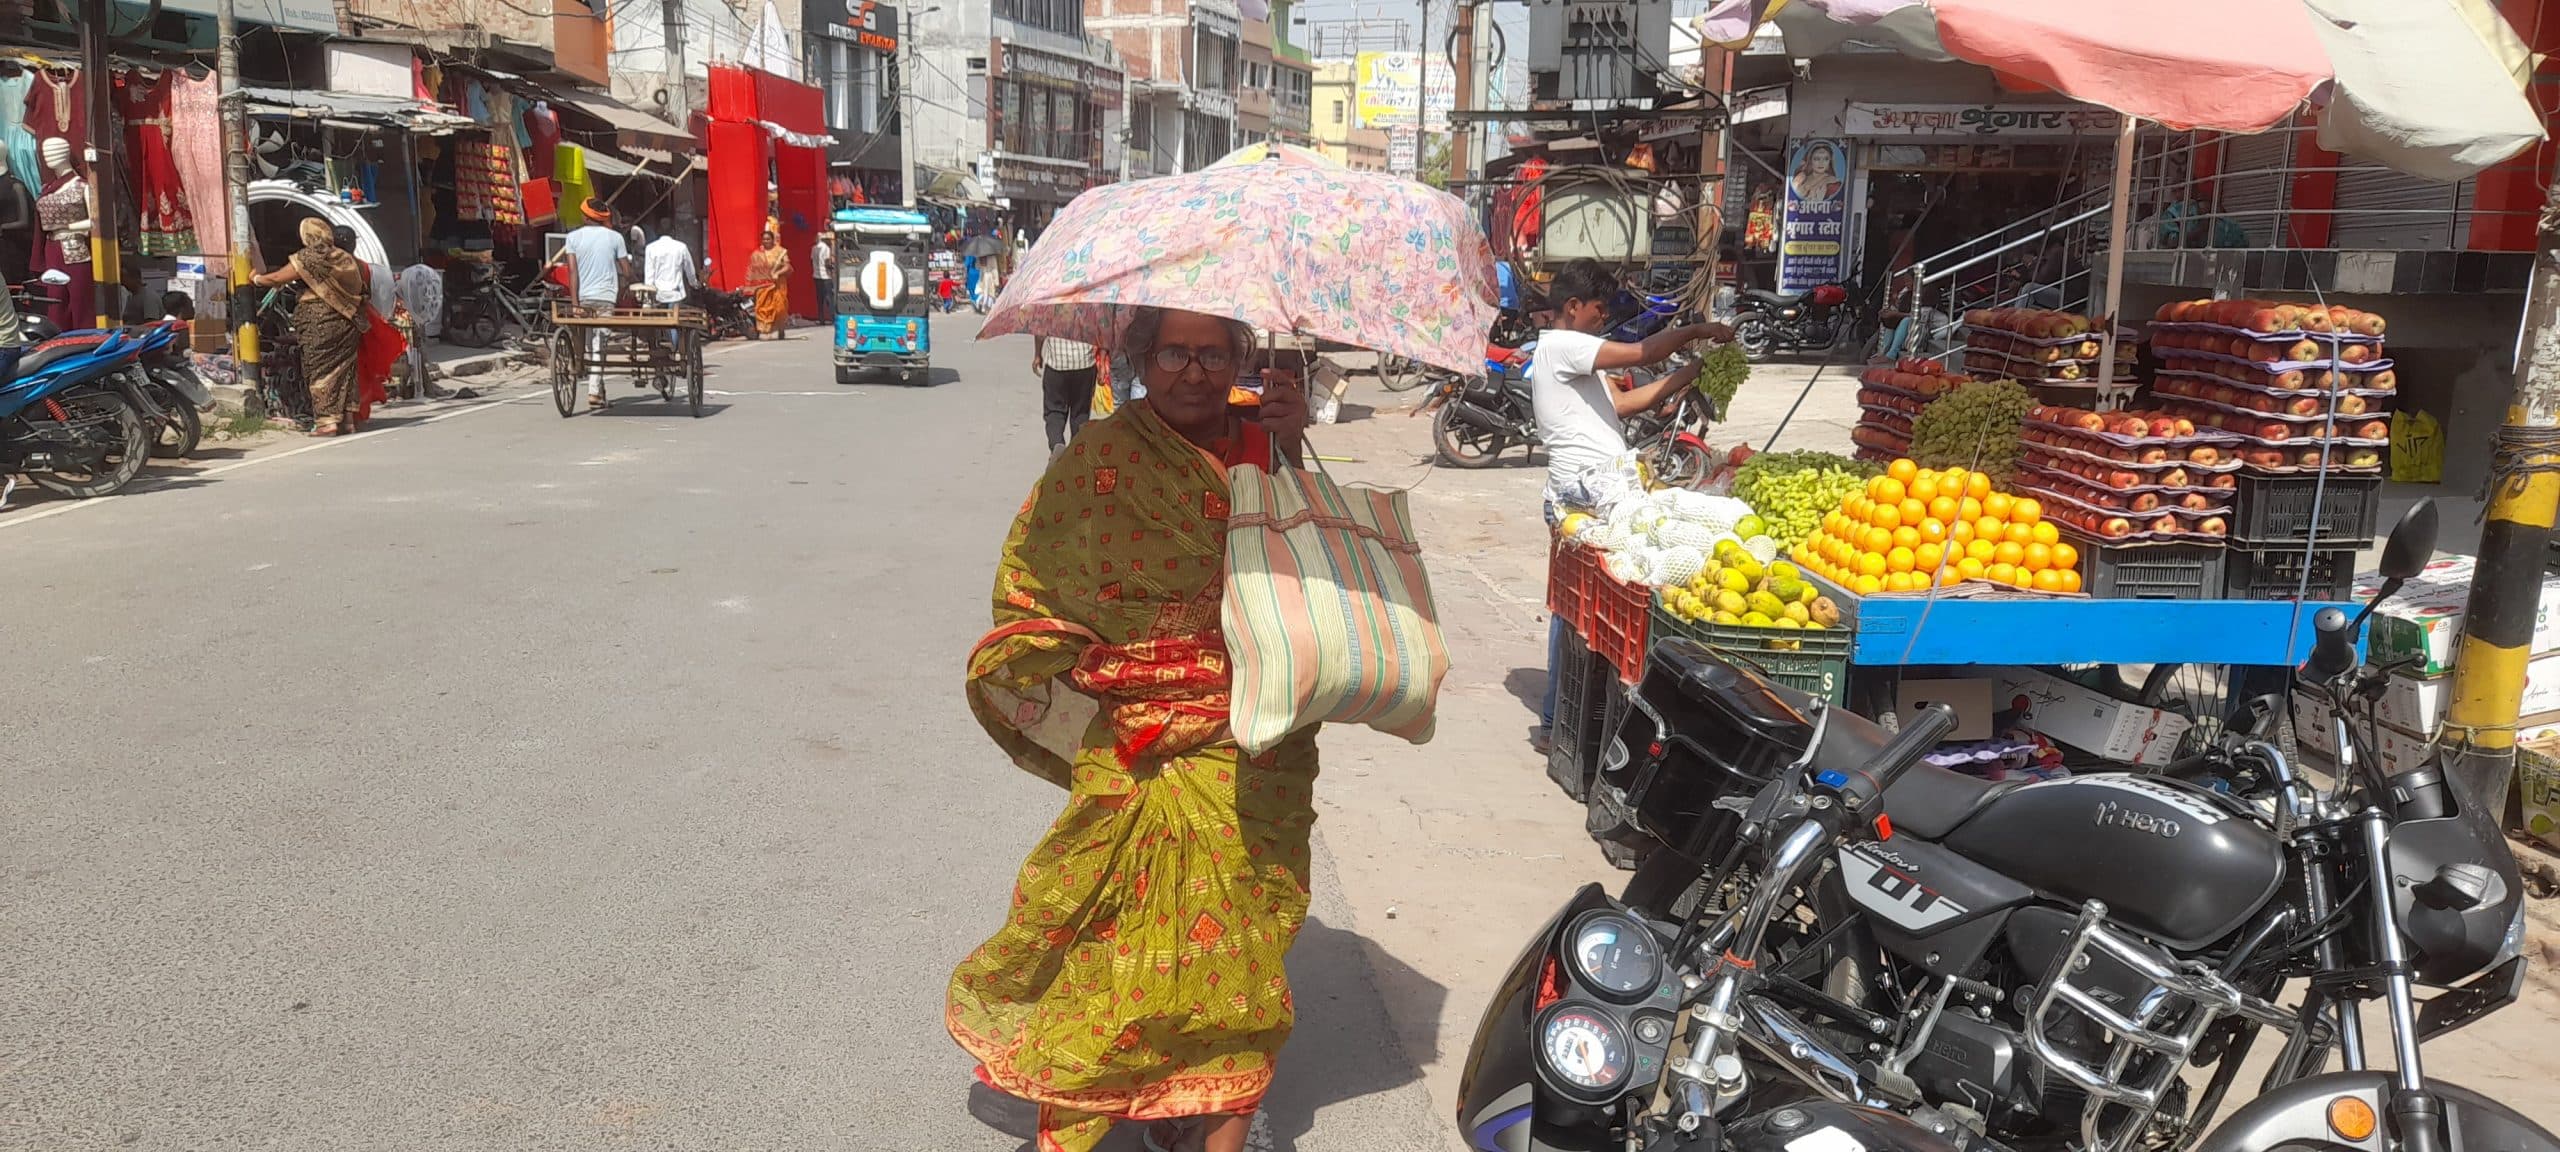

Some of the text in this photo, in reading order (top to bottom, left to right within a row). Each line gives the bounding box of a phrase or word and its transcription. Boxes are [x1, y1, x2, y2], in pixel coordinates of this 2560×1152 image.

[1873, 107, 1958, 130] अपना
[1799, 200, 1831, 215] अपना
[1817, 218, 1842, 236] स्टोर
